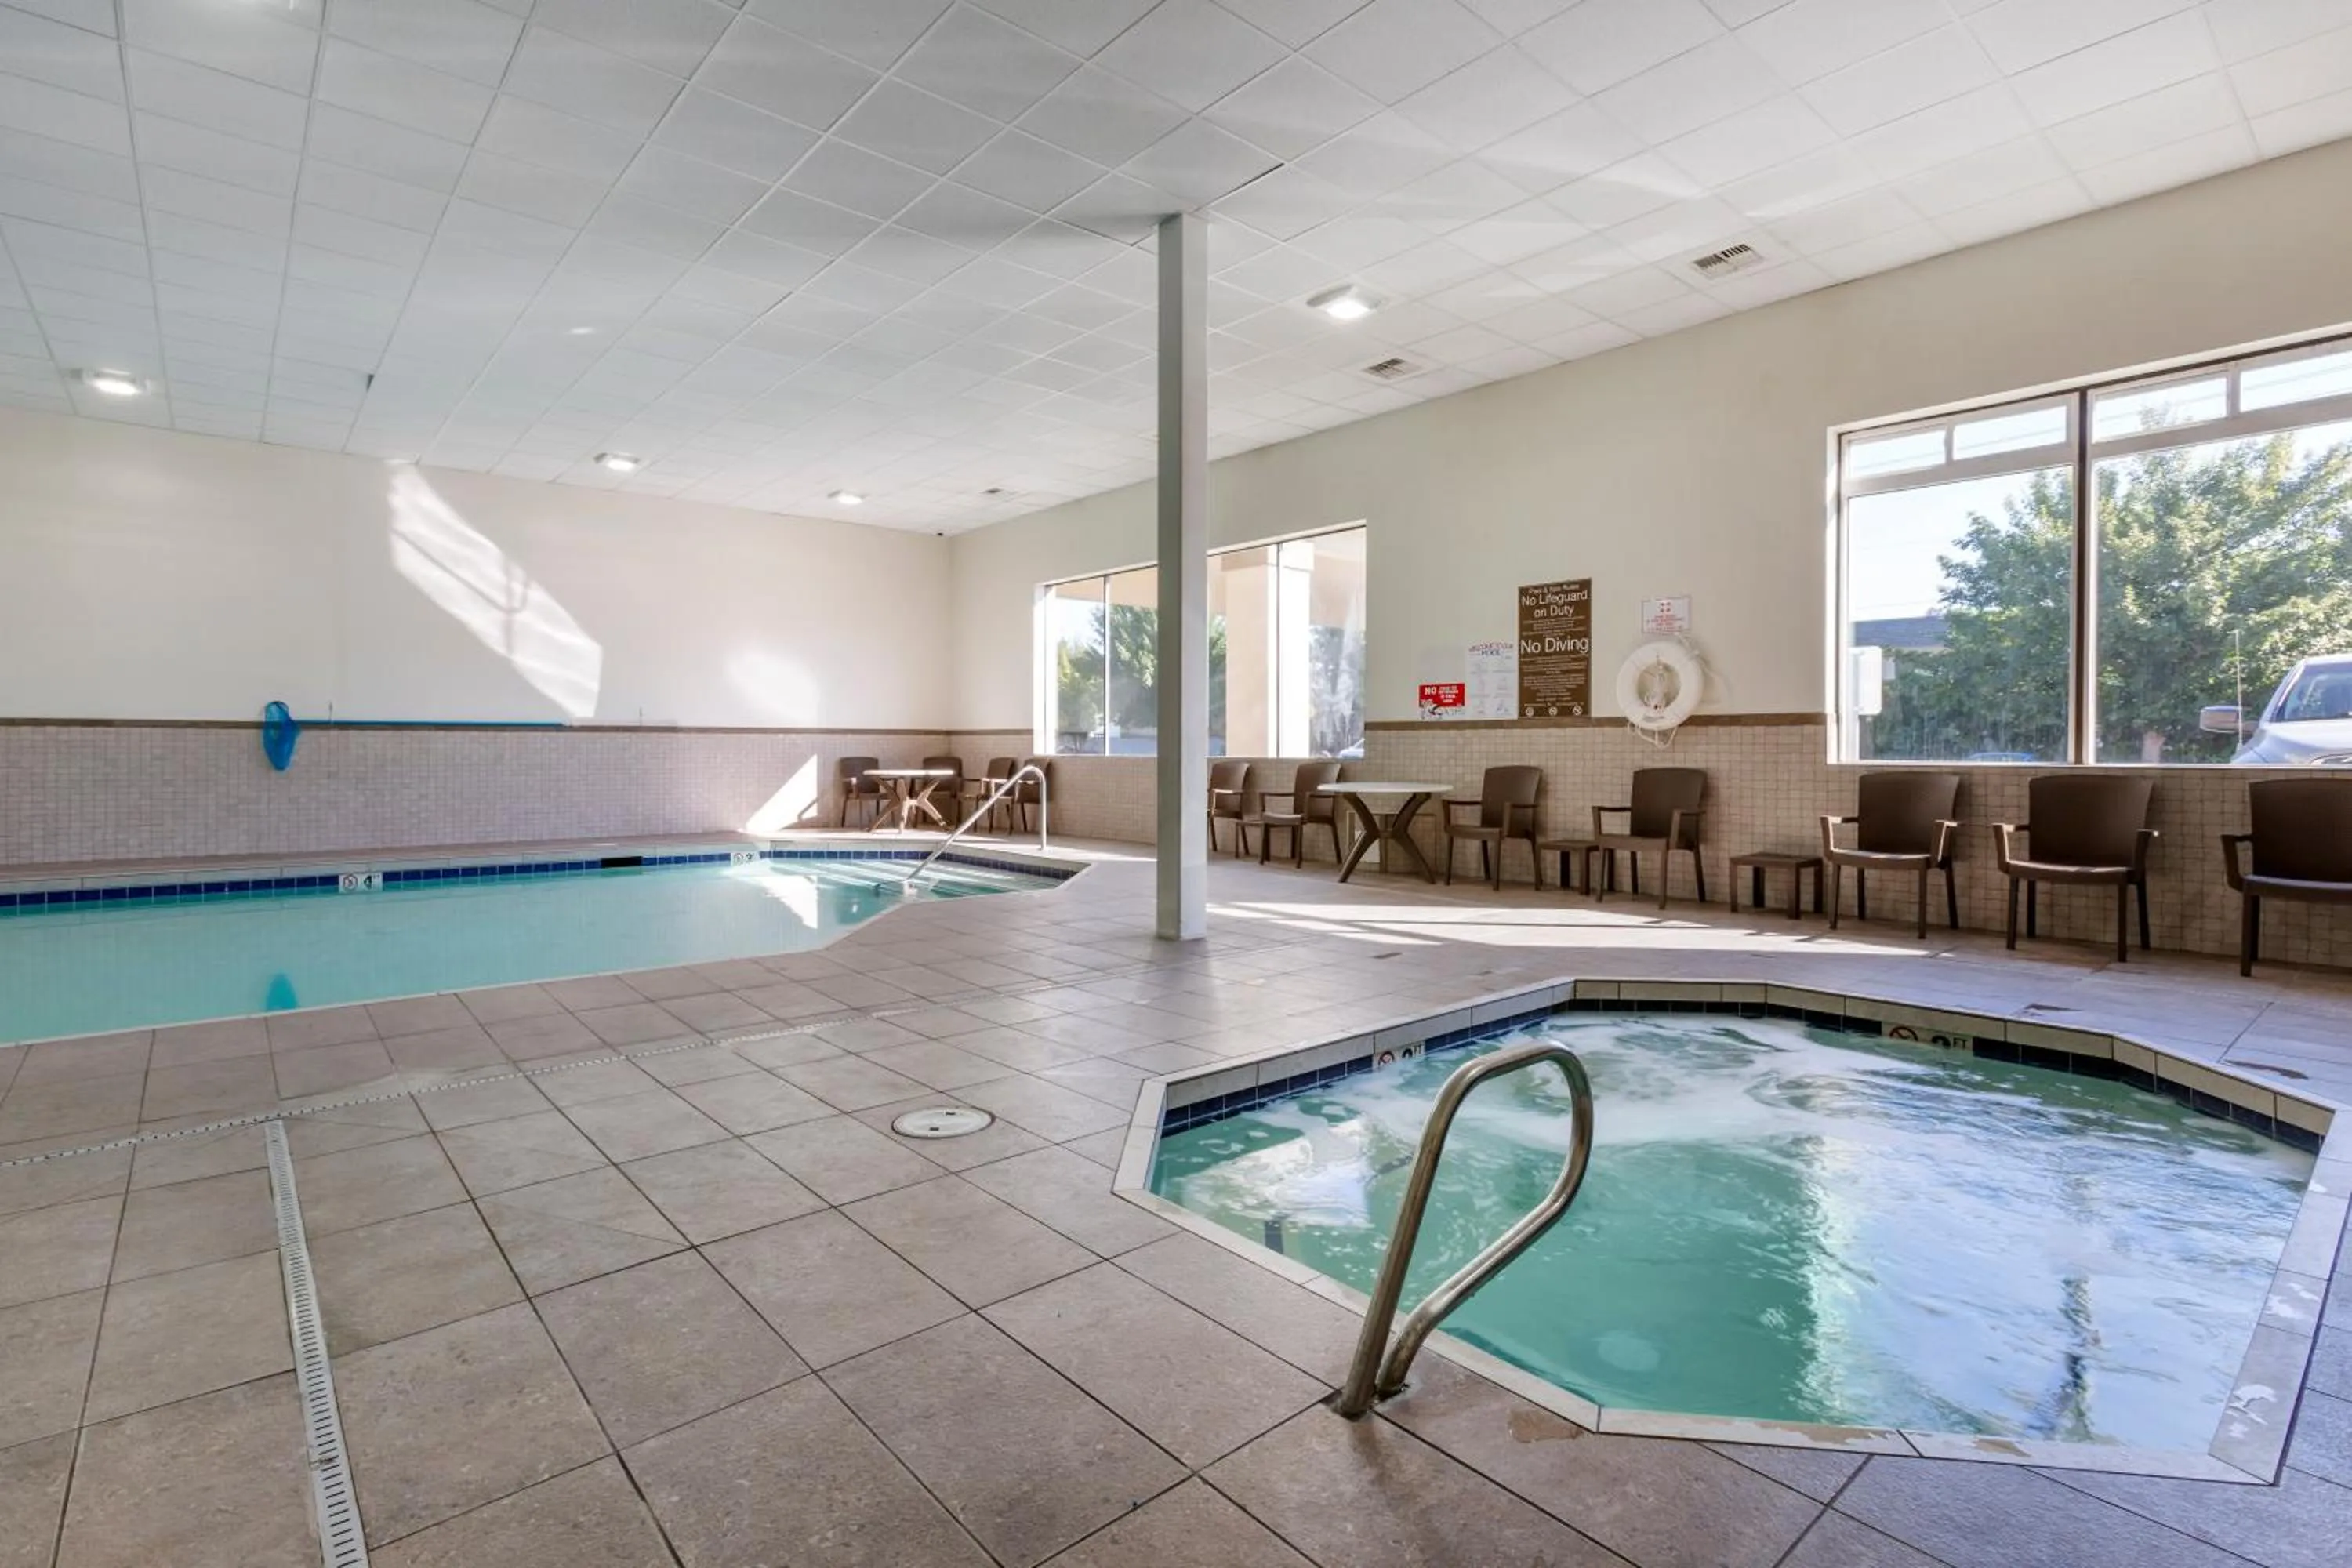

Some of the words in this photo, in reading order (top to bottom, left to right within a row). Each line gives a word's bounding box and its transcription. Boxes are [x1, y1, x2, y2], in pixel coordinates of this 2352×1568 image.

[1522, 595, 1536, 606] No
[1539, 590, 1588, 605] Lifeguard
[1534, 608, 1547, 618] on
[1550, 604, 1574, 618] Duty
[1520, 639, 1541, 655] No
[1545, 637, 1588, 654] Diving
[1425, 686, 1437, 695] NO
